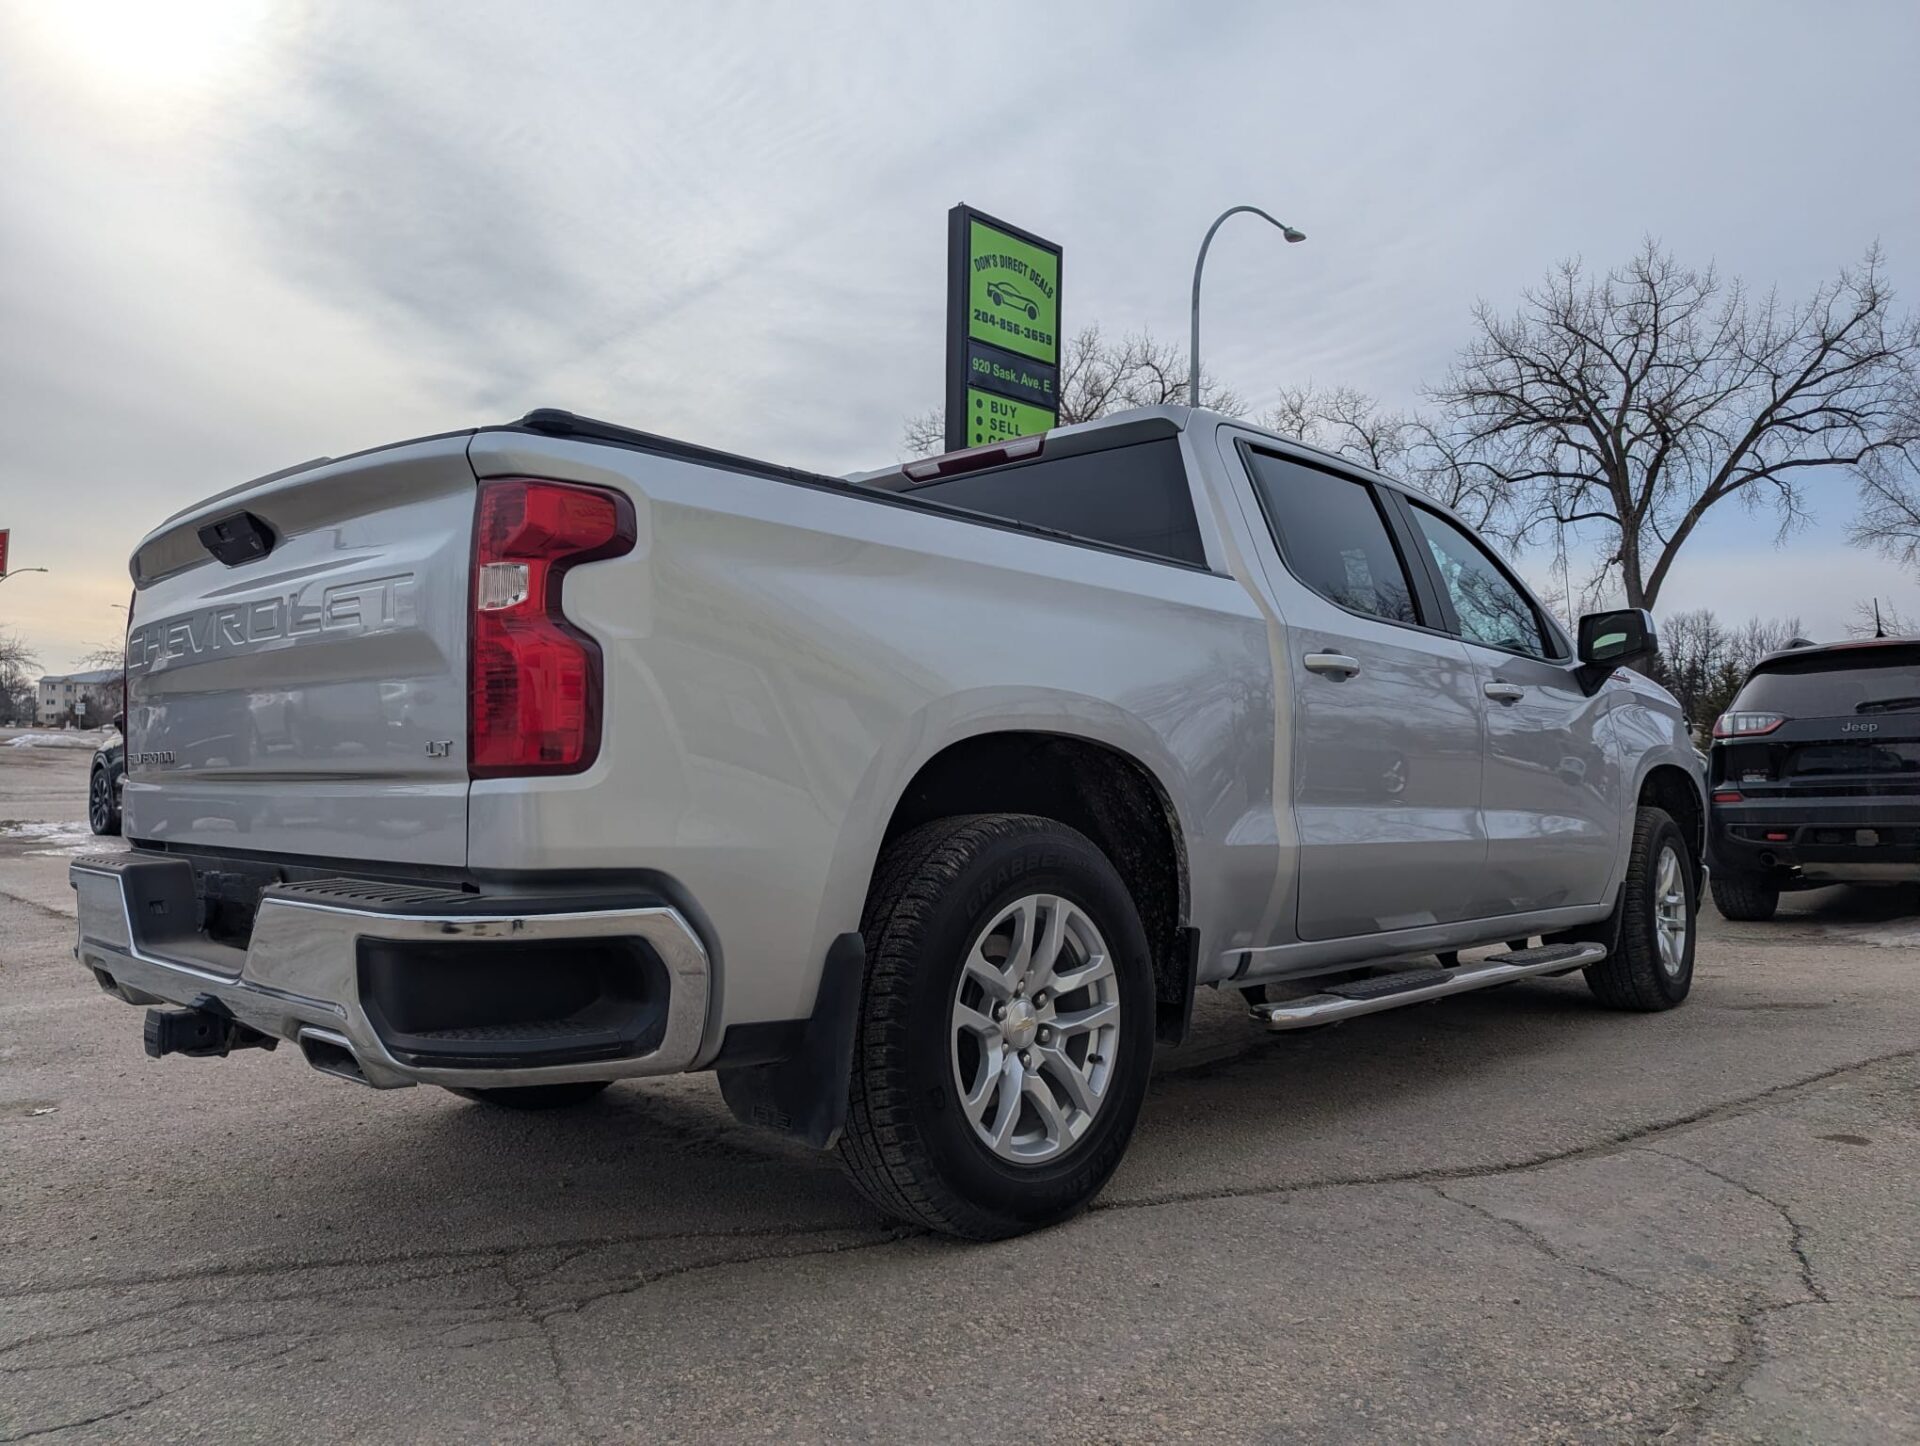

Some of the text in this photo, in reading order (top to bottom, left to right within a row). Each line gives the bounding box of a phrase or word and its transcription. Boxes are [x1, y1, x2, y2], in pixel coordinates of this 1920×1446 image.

[974, 254, 1054, 299] DON'S DIRECT DEALS
[974, 308, 1052, 346] 204-856-3659
[972, 356, 991, 374] 920
[993, 363, 1019, 383] Sask.
[1020, 372, 1042, 390] Ave.
[990, 400, 1017, 418] BUY
[990, 417, 1022, 437] SELL
[127, 571, 416, 670] CHEVROLET
[1841, 721, 1879, 733] Jeep
[424, 740, 453, 758] LT
